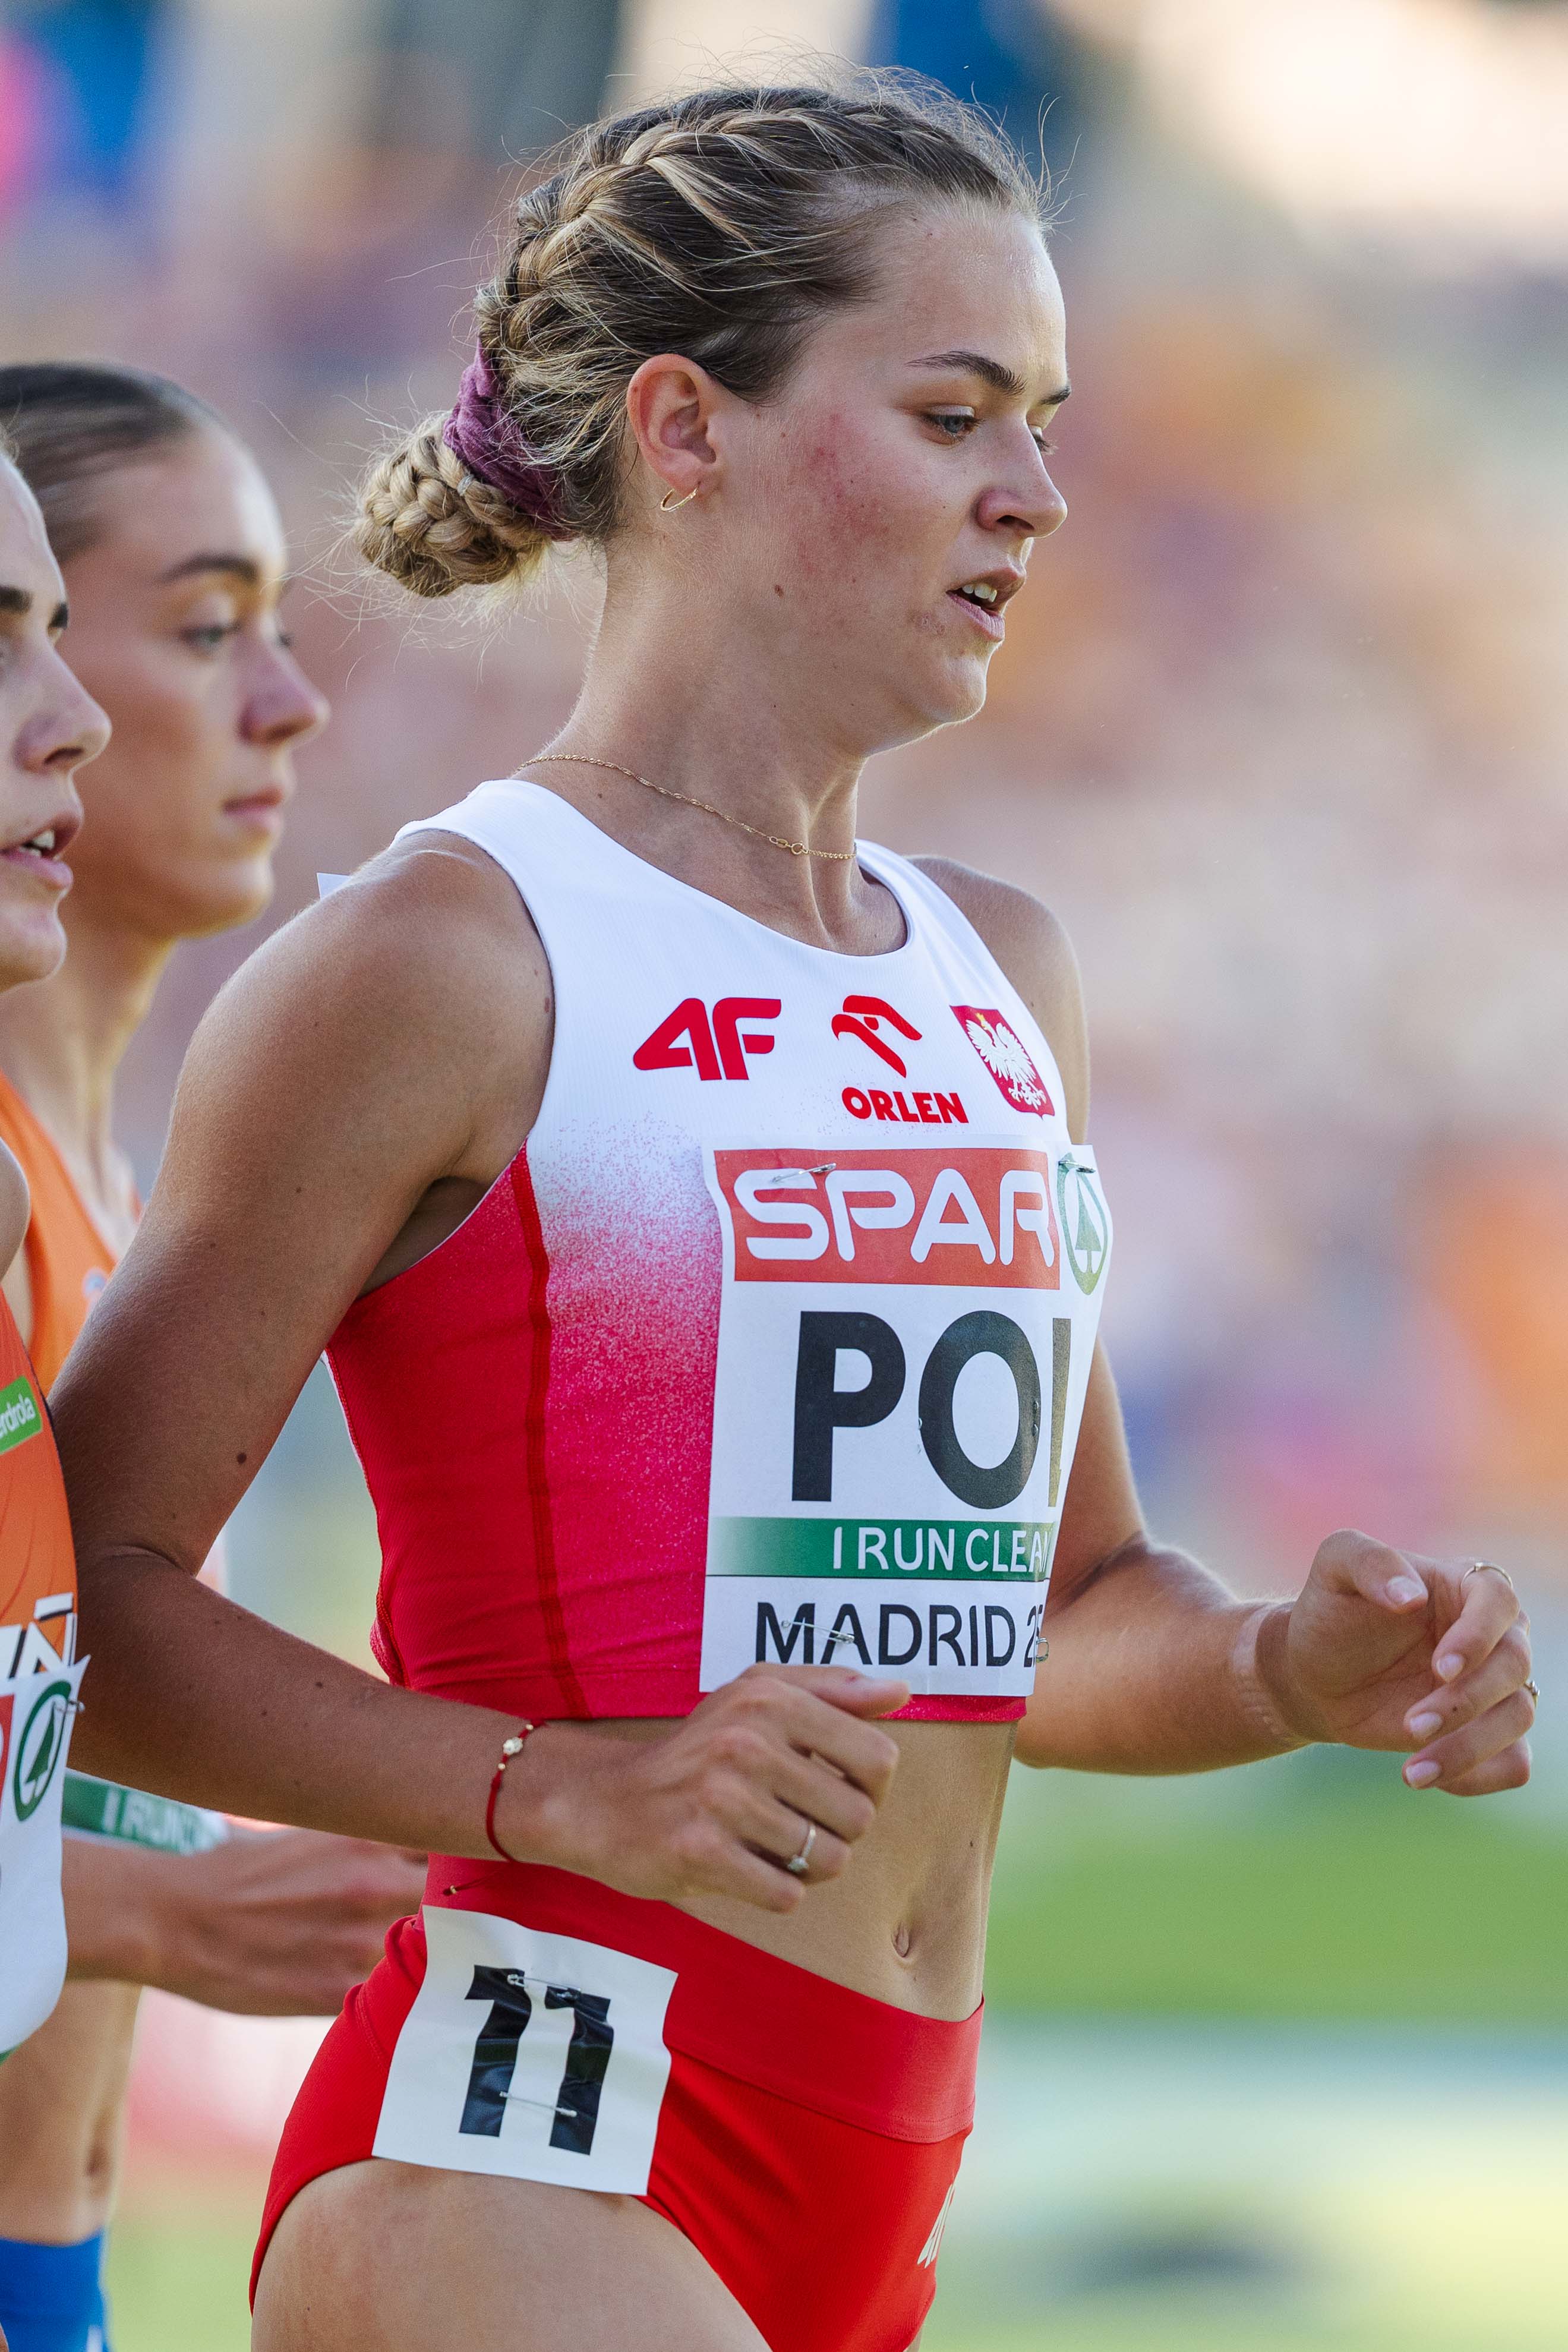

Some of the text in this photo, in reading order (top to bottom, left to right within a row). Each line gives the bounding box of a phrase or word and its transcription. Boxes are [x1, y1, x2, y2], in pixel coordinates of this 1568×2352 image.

[633, 997, 781, 1081] 4F
[841, 1087, 969, 1123] ORLEN
[734, 1168, 1055, 1268] SPAR
[833, 1527, 843, 1569] I
[857, 1527, 954, 1571] RUN
[755, 1601, 1016, 1667] MADRID
[459, 1964, 614, 2156] 11
